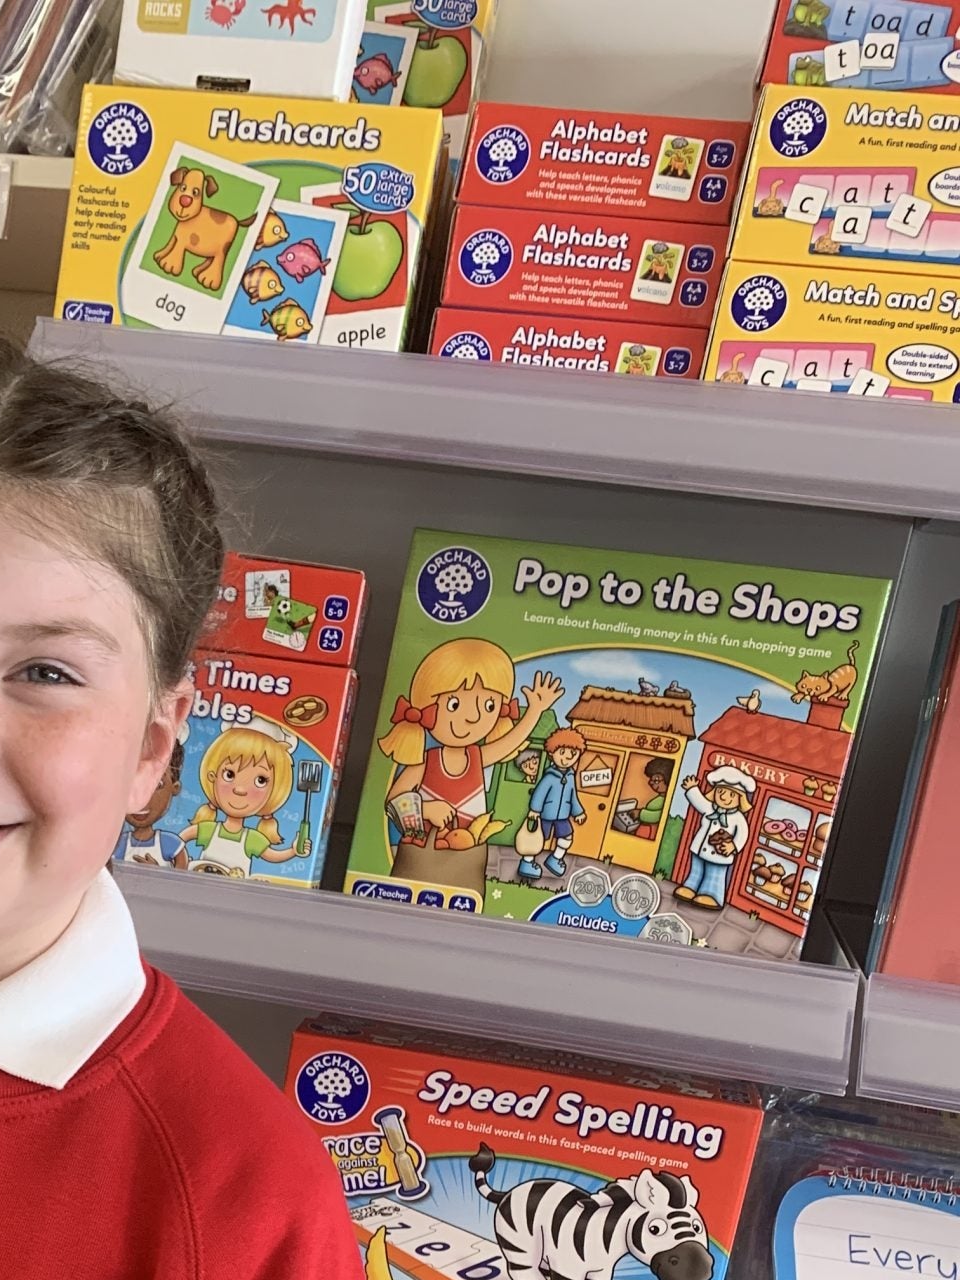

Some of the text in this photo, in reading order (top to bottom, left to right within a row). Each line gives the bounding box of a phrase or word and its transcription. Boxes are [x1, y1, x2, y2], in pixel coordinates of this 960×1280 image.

[94, 105, 149, 134] ORCHARD
[845, 103, 922, 128] Match
[209, 110, 381, 150] Flashcards
[551, 120, 647, 145] Alphabet
[482, 128, 528, 152] ORCHARD
[100, 156, 134, 173] TOYS
[540, 142, 651, 168] Flashcards
[711, 154, 728, 164] 3-7
[345, 167, 375, 193] 50
[380, 169, 412, 185] extra
[487, 170, 513, 182] TOYS
[78, 186, 116, 196] Colourful
[376, 181, 409, 197] large
[77, 195, 129, 208] flashcards to
[373, 193, 407, 207] cards
[75, 207, 126, 221] help develop
[74, 220, 126, 233] early reading
[71, 240, 90, 250] skills
[73, 230, 121, 243] and number
[533, 224, 629, 249] Alphabet
[522, 245, 631, 271] Flashcards
[738, 278, 784, 300] ORCHARD
[805, 280, 935, 311] Match and
[155, 294, 186, 322] dog
[741, 318, 768, 330] TOYS
[827, 314, 842, 323] fun,
[845, 316, 862, 324] first
[864, 318, 894, 329] reading
[898, 321, 914, 329] and
[916, 321, 947, 333] spelling
[337, 324, 386, 345] apple
[511, 327, 607, 351] Alphabet
[893, 359, 917, 368] boards
[902, 350, 948, 360] Double-sided
[906, 369, 935, 378] learning
[426, 550, 486, 581] ORCHARD
[514, 559, 861, 637] Pop to the Shops
[328, 607, 343, 617] 5-9
[431, 603, 469, 620] TOYS
[322, 639, 338, 648] 2-4
[523, 611, 832, 659] Learn about handling money in this fun shopping game
[206, 660, 291, 695] Times
[584, 770, 611, 785] OPEN
[713, 753, 791, 786] BAKERY
[575, 880, 606, 898] 20p
[620, 886, 650, 911] 10p
[558, 912, 617, 932] Includes
[305, 1054, 366, 1086] ORCHARD
[311, 1106, 346, 1122] TOYS
[418, 1071, 724, 1158] Speed Spelling
[428, 1114, 688, 1169] Race to build words in this fast-paced spelling game
[339, 1155, 379, 1169] against
